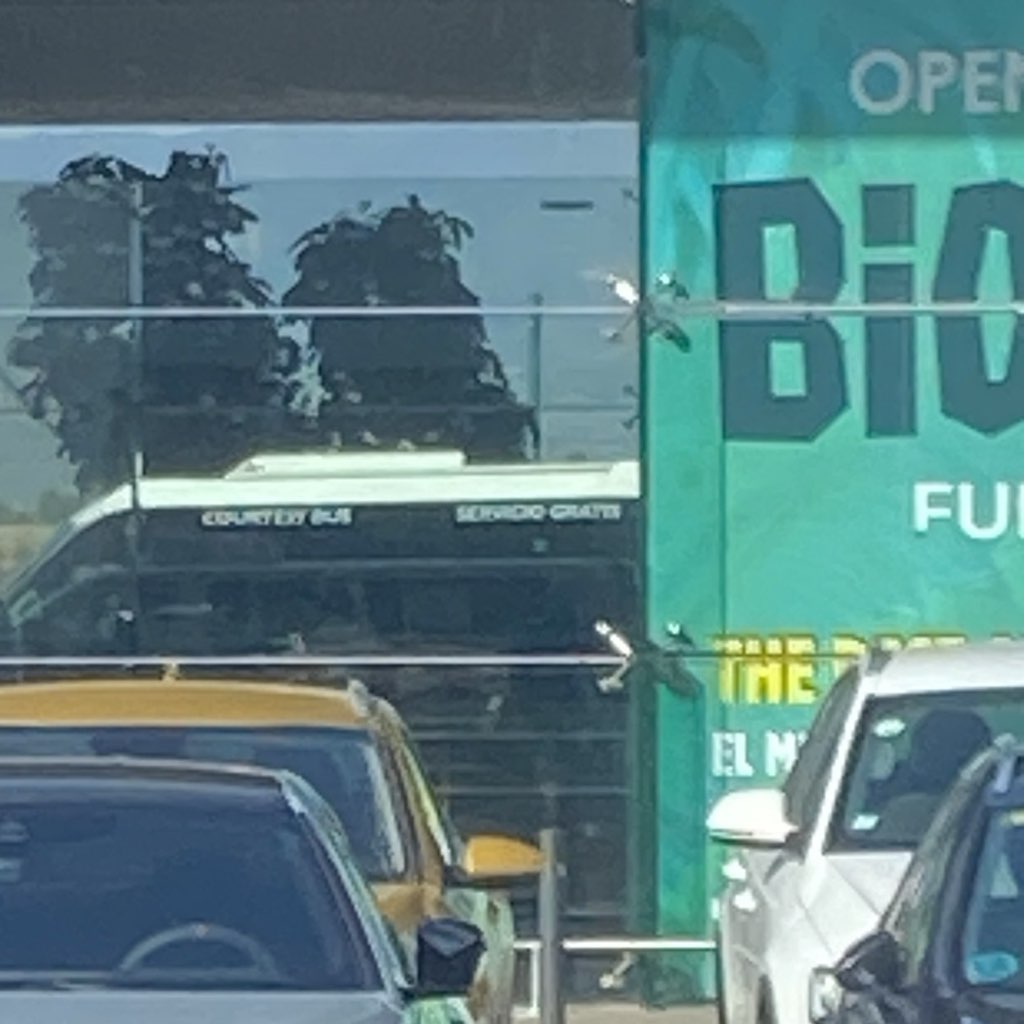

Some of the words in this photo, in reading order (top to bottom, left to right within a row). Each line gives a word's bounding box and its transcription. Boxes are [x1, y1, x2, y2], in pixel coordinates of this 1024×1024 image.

[913, 481, 1024, 540] FU
[714, 634, 819, 705] THE
[712, 731, 753, 777] EL
